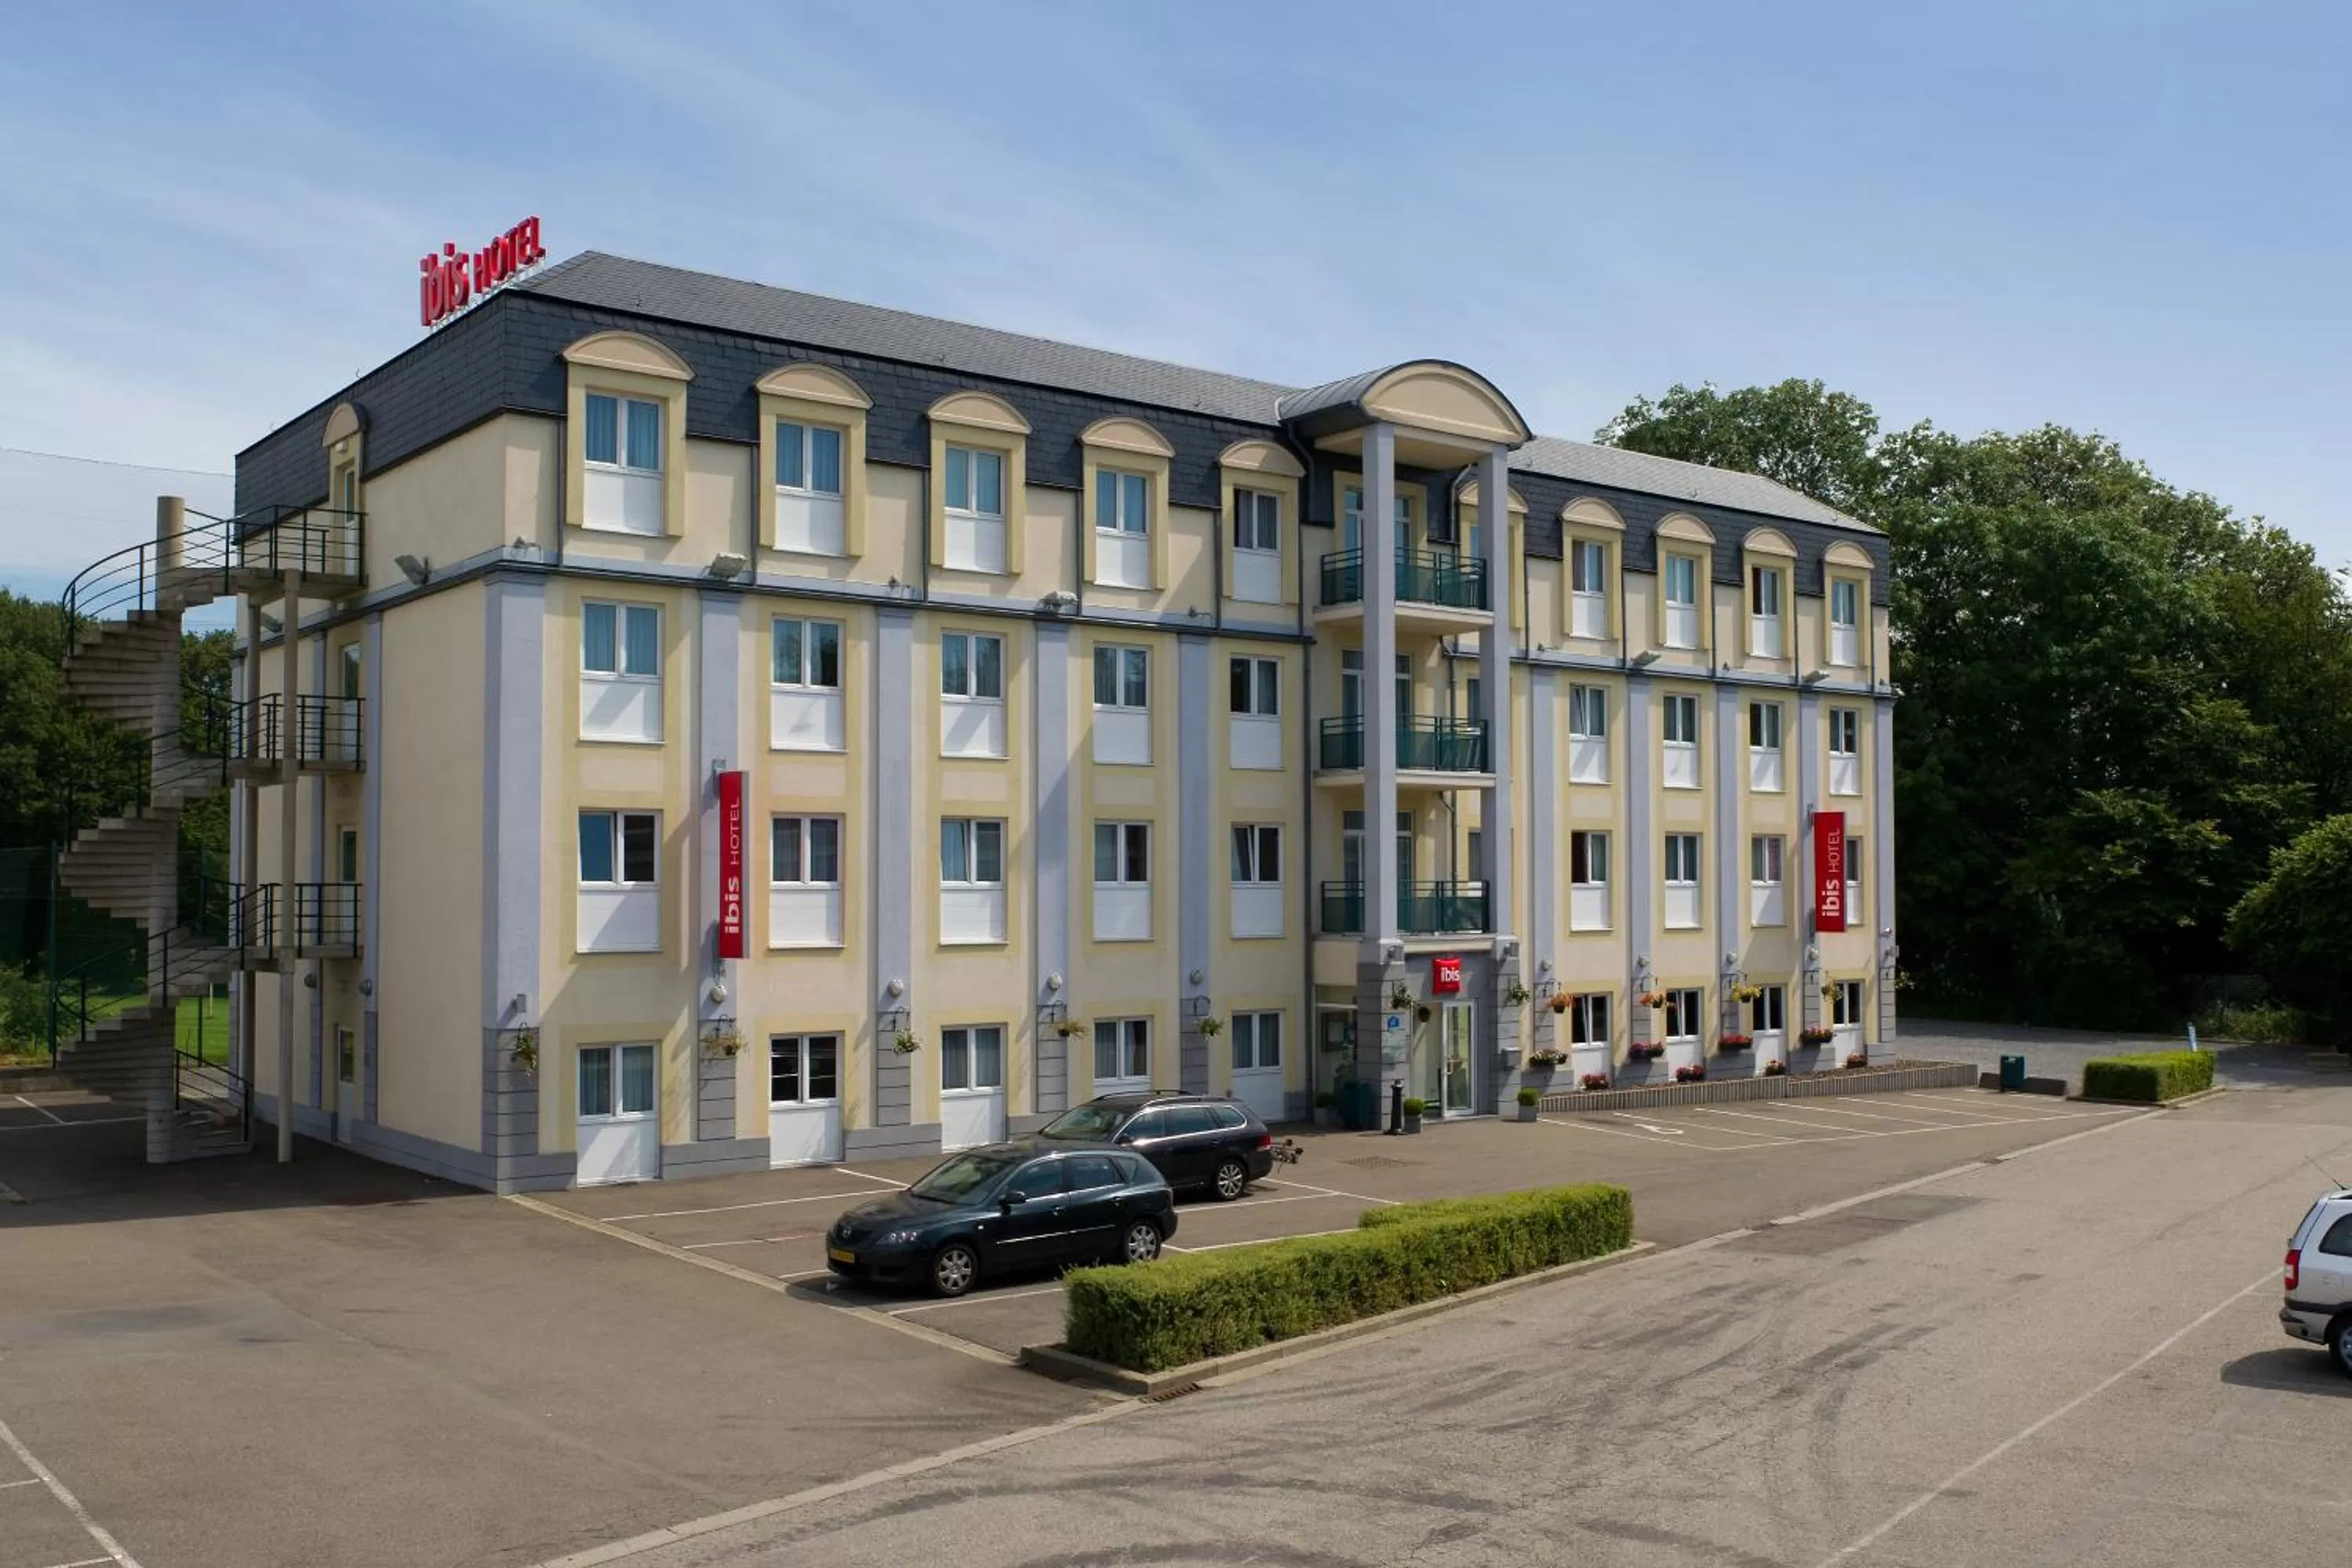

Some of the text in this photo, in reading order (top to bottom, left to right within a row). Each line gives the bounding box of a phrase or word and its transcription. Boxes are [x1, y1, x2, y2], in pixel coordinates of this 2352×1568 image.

[420, 216, 546, 326] ibis HOTEL
[725, 796, 739, 935] ibis HOTEL
[1821, 828, 1840, 916] ibis HOTEL
[1440, 967, 1460, 982] ibis
